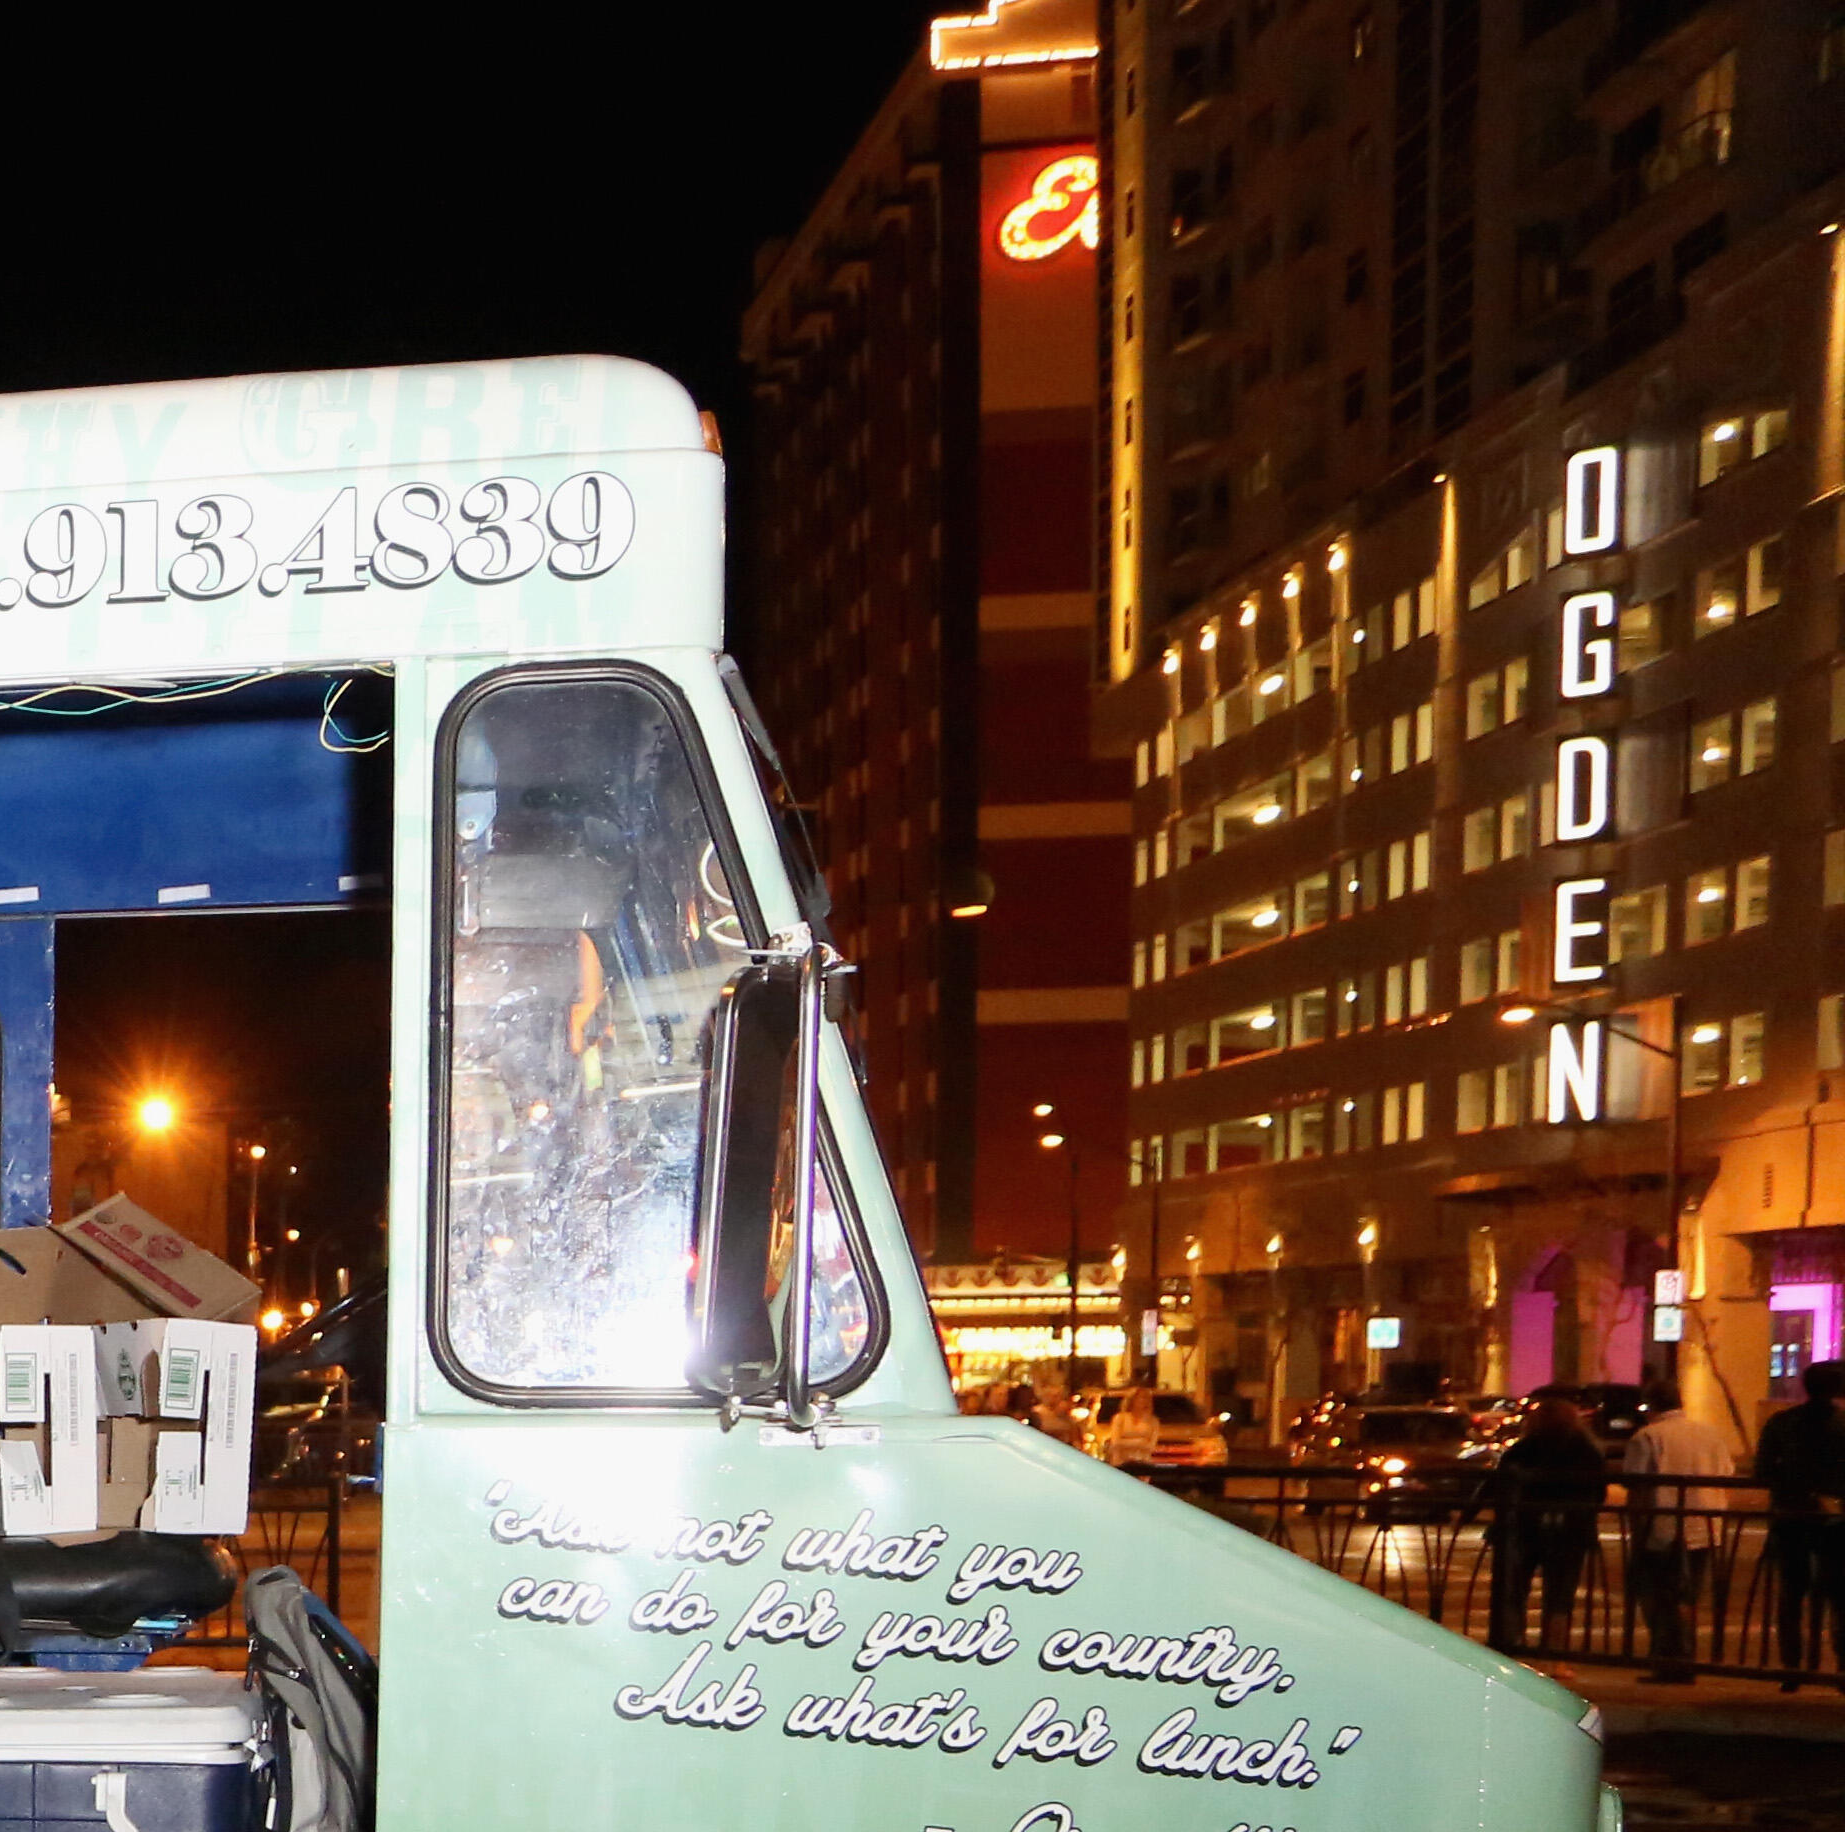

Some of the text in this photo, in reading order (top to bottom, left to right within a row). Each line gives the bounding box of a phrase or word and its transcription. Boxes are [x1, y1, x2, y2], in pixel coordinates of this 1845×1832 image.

[1548, 446, 1618, 1125] OGDEN
[780, 1508, 949, 1586] what
[945, 1538, 1084, 1614] you
[497, 1568, 1298, 1708] can do for your country.
[613, 1640, 1363, 1788] Ask what's for lunch."
